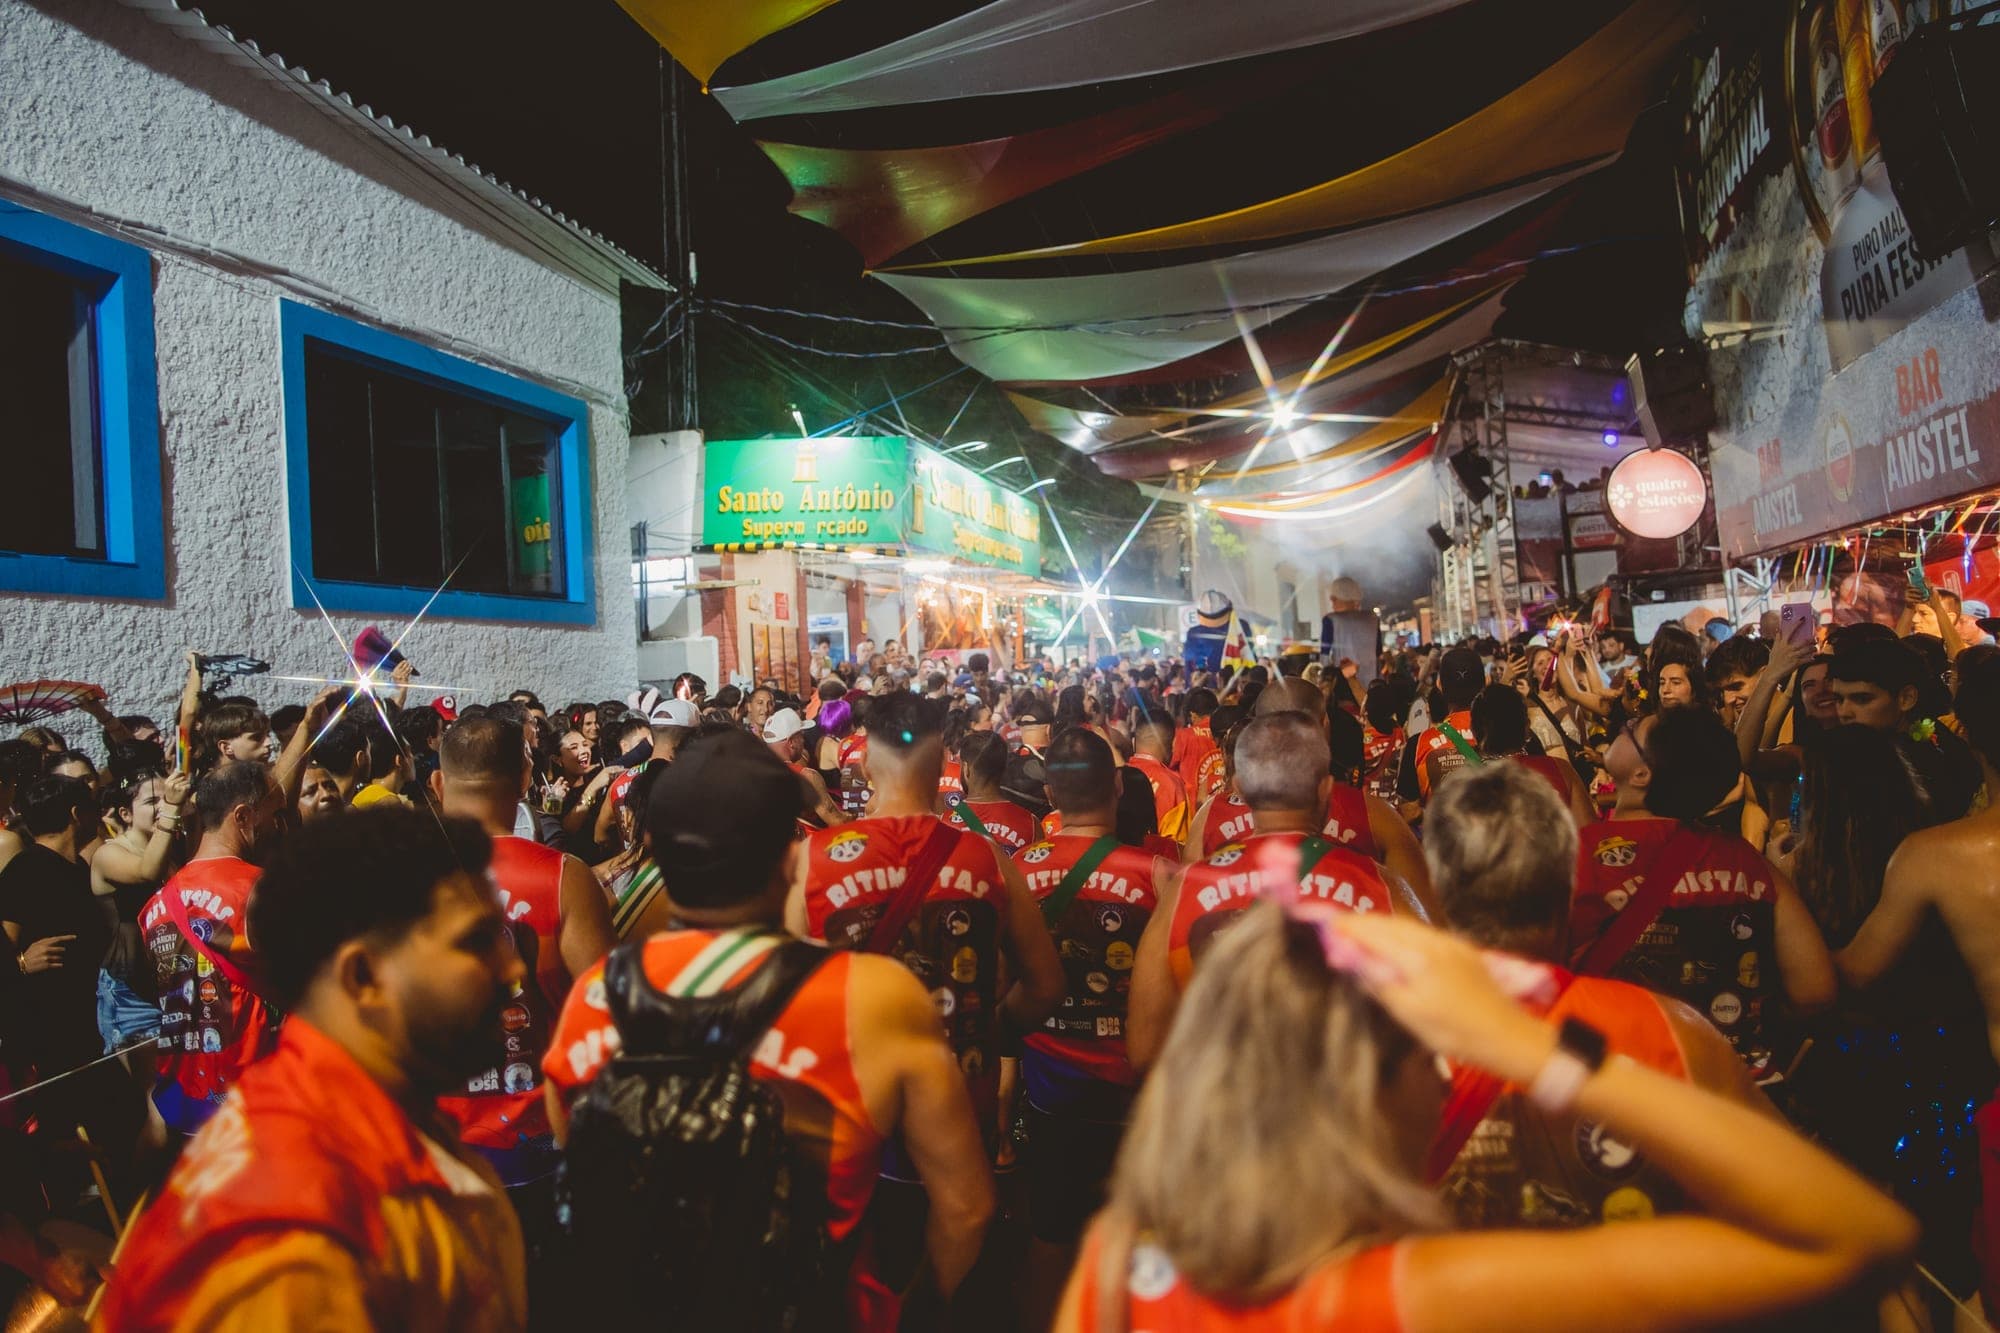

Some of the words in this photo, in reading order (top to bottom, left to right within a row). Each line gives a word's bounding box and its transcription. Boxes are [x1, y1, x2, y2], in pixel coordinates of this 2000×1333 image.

[1852, 227, 1880, 272] PURO
[1880, 206, 1906, 249] MAL
[1841, 262, 1889, 325] PURA
[1887, 236, 1953, 298] FES
[1895, 347, 1944, 417] BAR
[1886, 405, 1980, 492] AMSTEL
[718, 485, 785, 513] Santo
[799, 481, 895, 512] Antônio
[1752, 482, 1804, 536] AMSTEL
